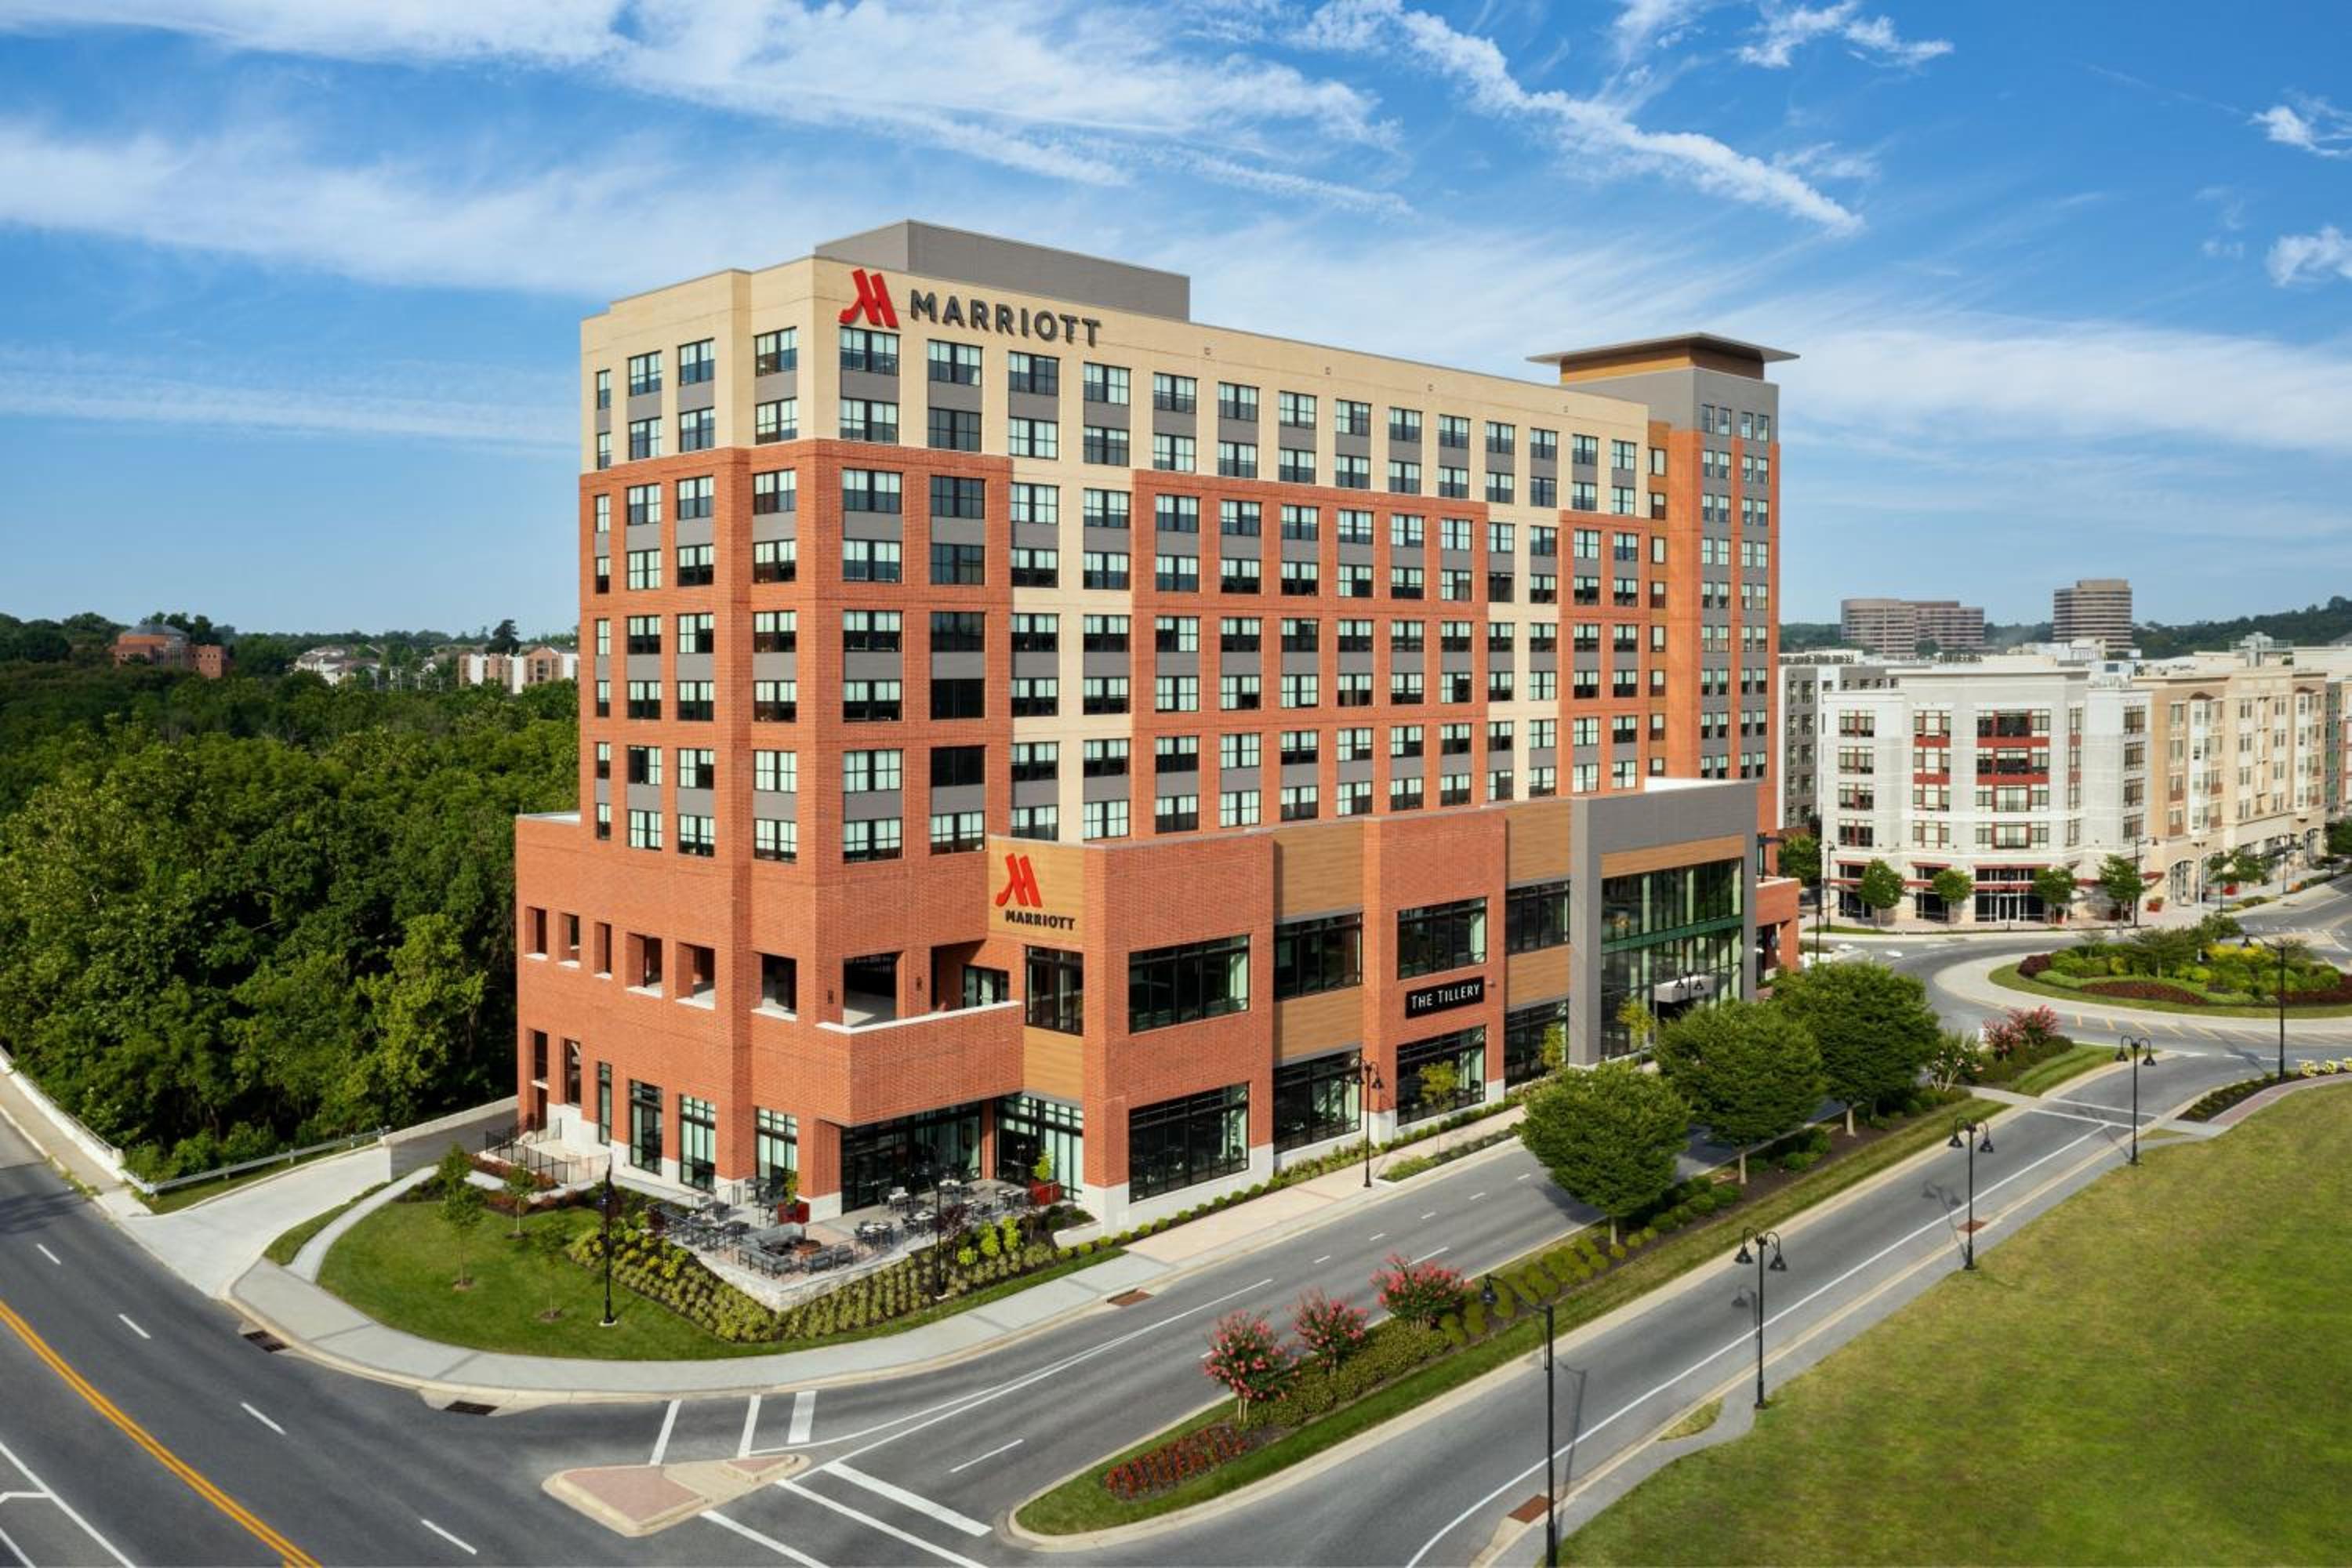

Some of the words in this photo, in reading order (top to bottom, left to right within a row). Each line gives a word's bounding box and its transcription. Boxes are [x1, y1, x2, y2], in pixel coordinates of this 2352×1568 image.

[910, 289, 1102, 347] MARRIOTT
[1005, 909, 1075, 931] MARRIOTT
[1411, 993, 1433, 1010] THE
[1437, 984, 1480, 1004] TILLERY
